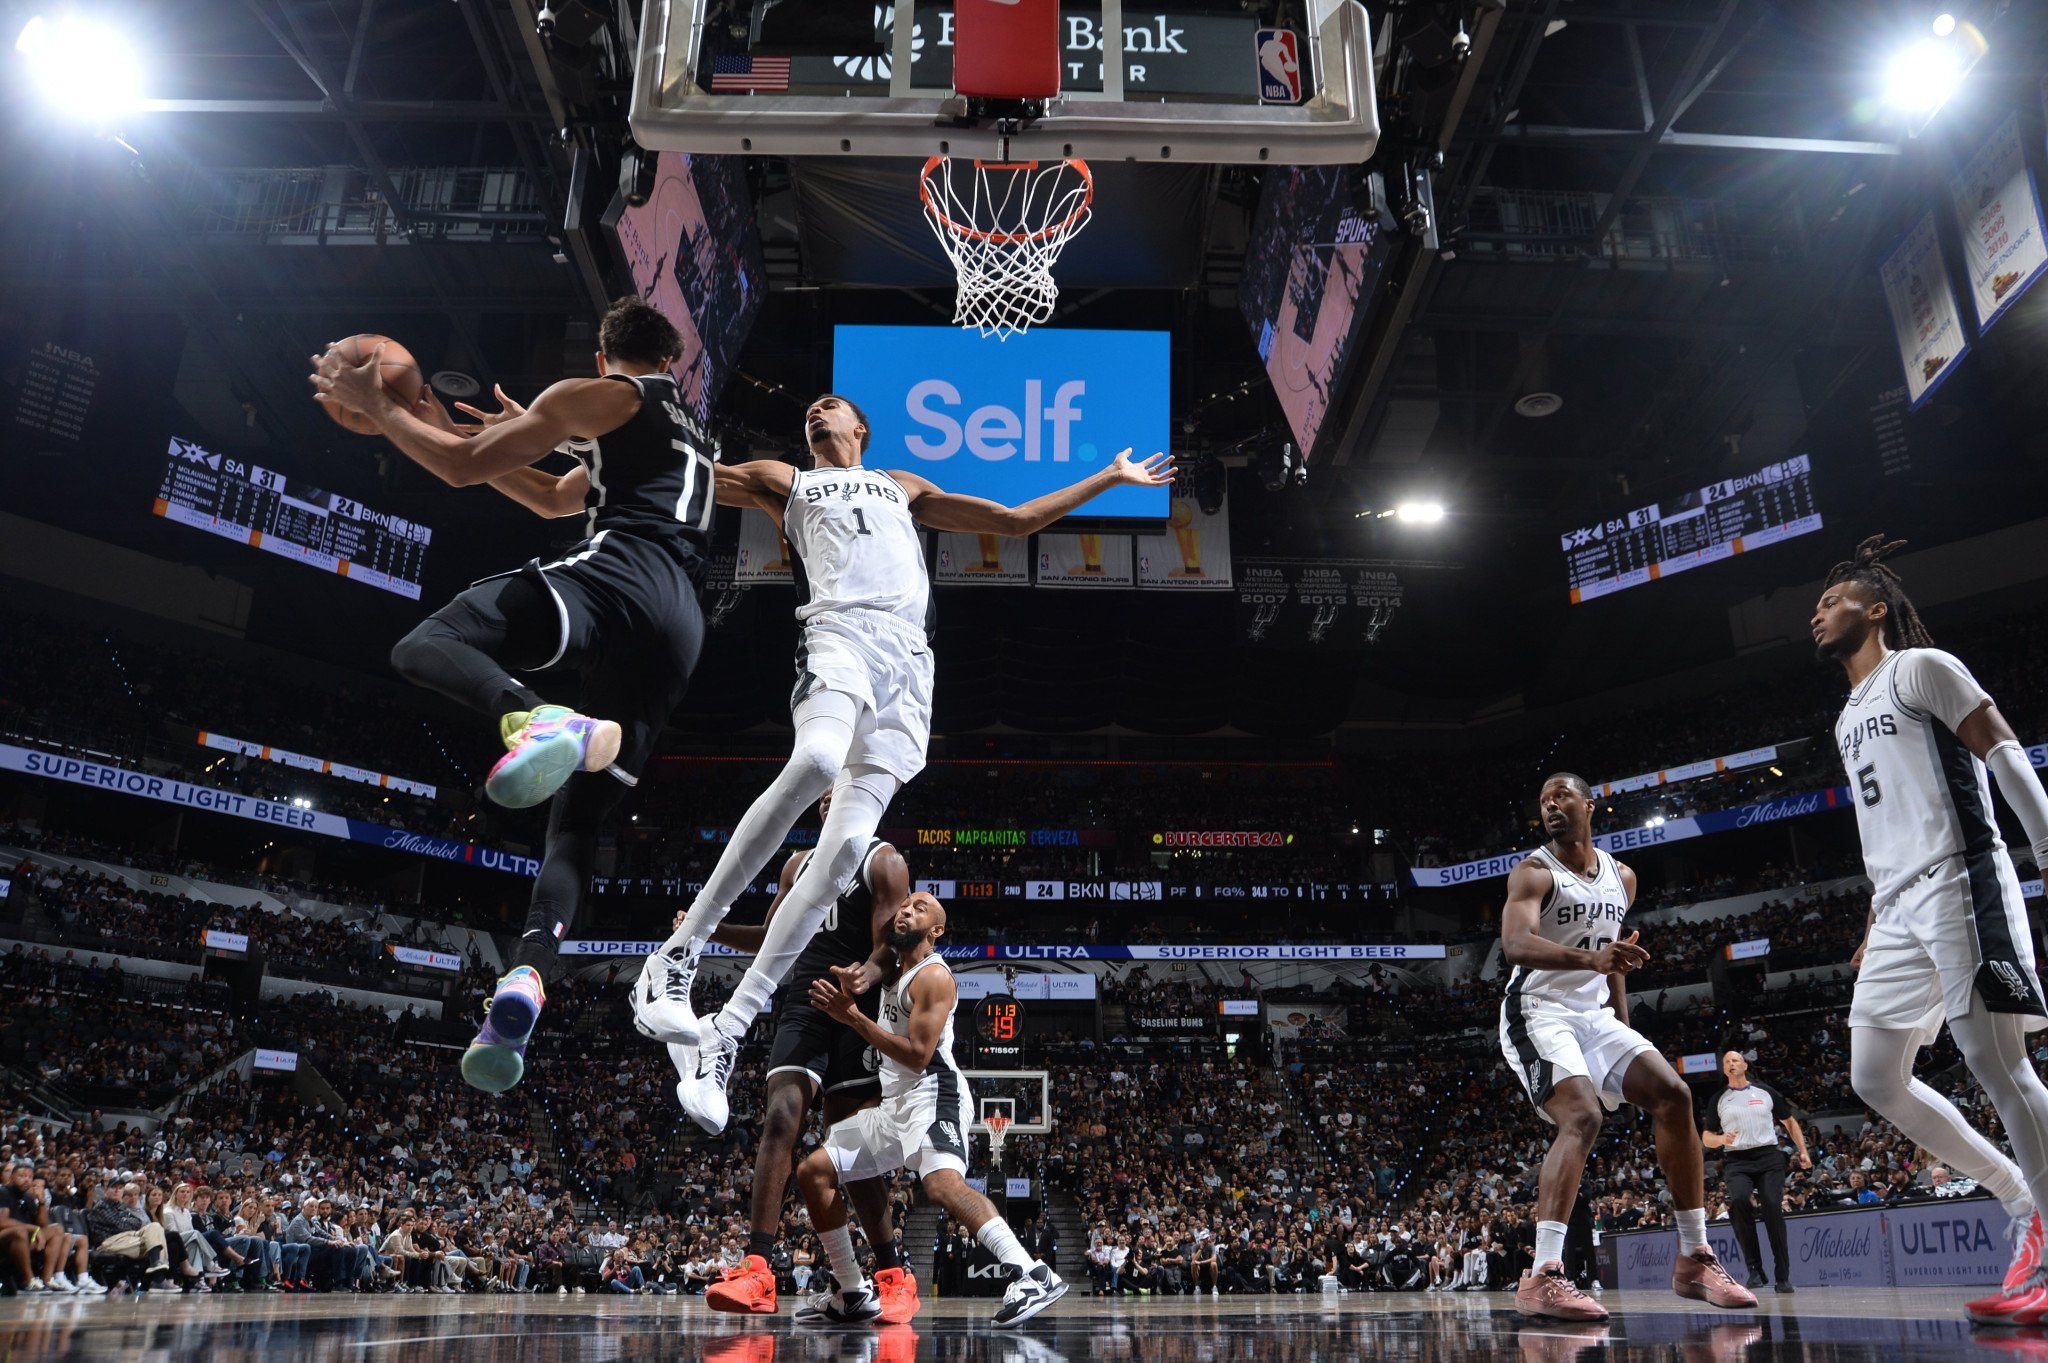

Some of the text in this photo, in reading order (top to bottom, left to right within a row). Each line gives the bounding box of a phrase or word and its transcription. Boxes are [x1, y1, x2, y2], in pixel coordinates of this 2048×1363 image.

[1066, 15, 1187, 54] Bnk
[1265, 86, 1286, 98] NBA
[1987, 232, 2009, 259] 2010
[225, 459, 245, 477] SA
[174, 481, 197, 493] CASTLE
[260, 471, 276, 489] 31
[1734, 472, 1763, 492] BKN
[806, 482, 898, 504] SPURS
[1709, 483, 1728, 500] 24
[337, 498, 355, 516] 24
[362, 507, 390, 528] BKN
[852, 507, 872, 535] 1
[1636, 508, 1651, 524] 31
[1606, 518, 1625, 534] SA
[337, 529, 359, 541] MARTIN
[1251, 569, 1283, 577] NBA
[1308, 569, 1341, 577] NBA
[1364, 571, 1397, 580] NBA
[1241, 594, 1287, 604] 2007
[1300, 595, 1347, 605] 2013
[1356, 597, 1402, 607] 2014
[1858, 762, 1883, 809] 5
[24, 753, 541, 877] SUPERIOR LIGHT BEER Michelob ULTR
[918, 830, 950, 845] TACOS
[1165, 832, 1283, 846] BURGERTECA
[1440, 795, 1818, 884] SUPERIO BEER Michelob
[928, 883, 940, 897] 31
[962, 884, 993, 897] 11:13
[1005, 886, 1020, 896] 2ND
[1038, 884, 1053, 897] 24
[1069, 883, 1104, 898] BKN
[1171, 887, 1187, 896] PF
[1214, 887, 1245, 897] FG%
[1252, 886, 1268, 897] 34.8
[1272, 887, 1289, 897] TO
[1557, 902, 1624, 927] SPURS
[577, 942, 663, 954] SUPERI
[1006, 946, 1090, 958] ULTRA
[1158, 947, 1270, 958] SUPERIOR
[1279, 947, 1342, 958] LIGHT
[1351, 946, 1407, 957] BEER
[988, 1004, 1016, 1017] 11:13
[994, 1017, 1014, 1038] 19
[1141, 1017, 1203, 1027] BASELINE BUMS
[1800, 1218, 1994, 1263] Michelob ULTRA
[1709, 1239, 1741, 1262] TRA
[1818, 1269, 1828, 1280] 26
[1903, 1265, 2000, 1277] SUPERIOR LIGHT BEER
